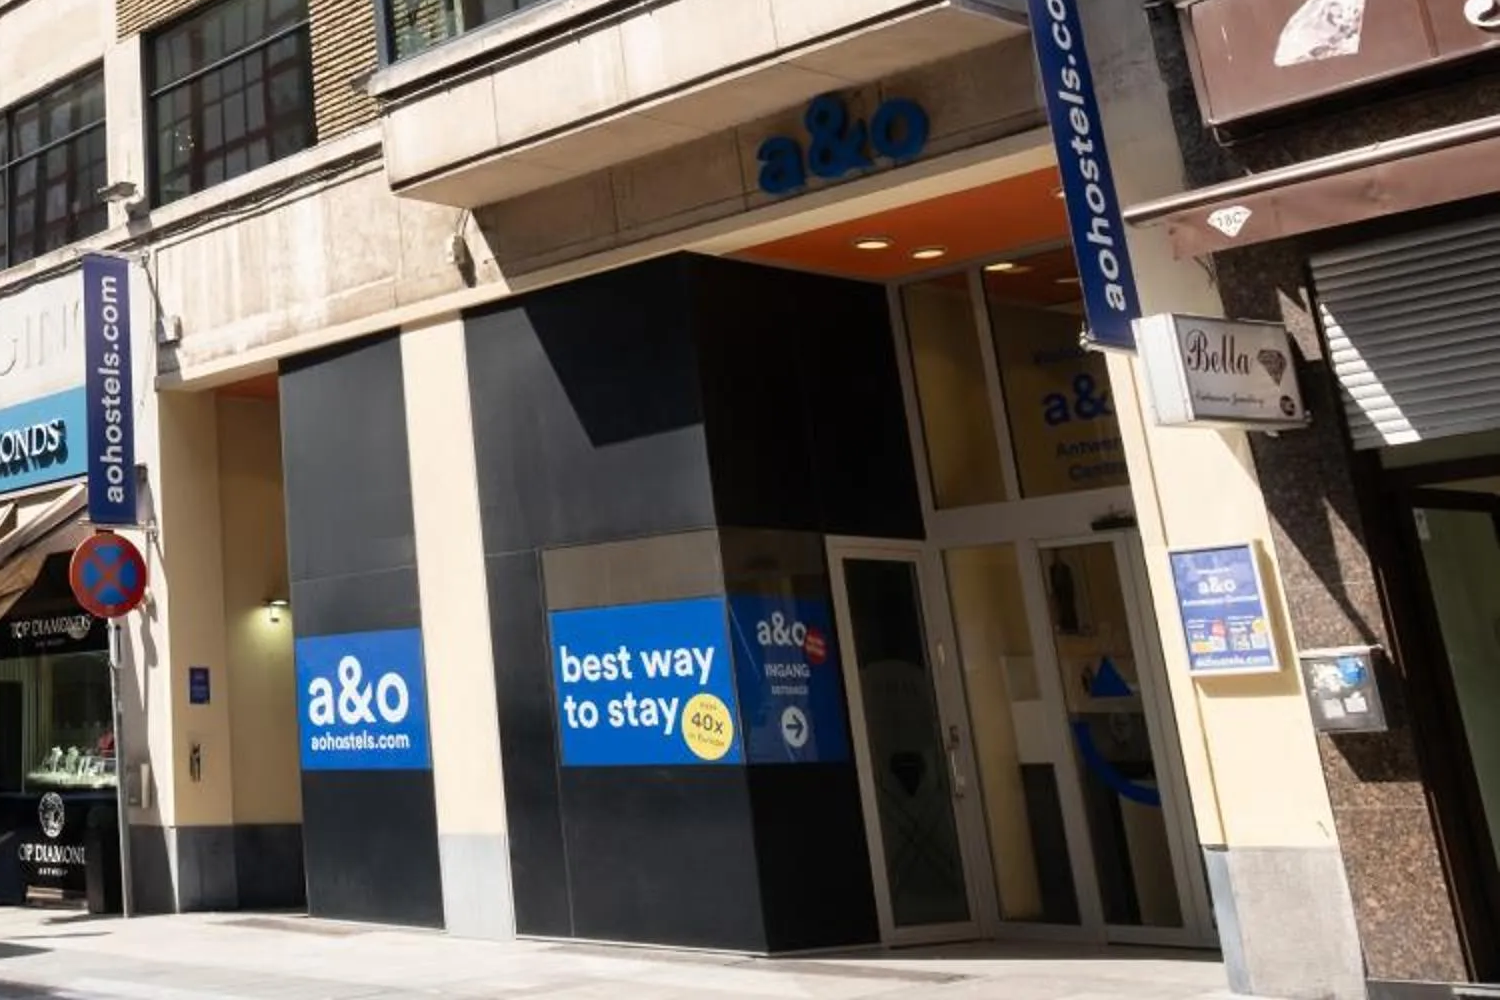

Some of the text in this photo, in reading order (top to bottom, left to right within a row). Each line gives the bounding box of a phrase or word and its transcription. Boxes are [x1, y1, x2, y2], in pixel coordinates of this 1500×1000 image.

[757, 95, 930, 195] a&o
[1185, 328, 1250, 376] Bella
[98, 274, 125, 503] aohostels.com
[1198, 576, 1236, 596] a&o
[756, 611, 807, 647] a&o
[560, 645, 715, 685] best way
[308, 655, 409, 726] a&o
[564, 691, 679, 735] to stay
[691, 711, 724, 736] 40x
[311, 730, 410, 751] aohostels.com
